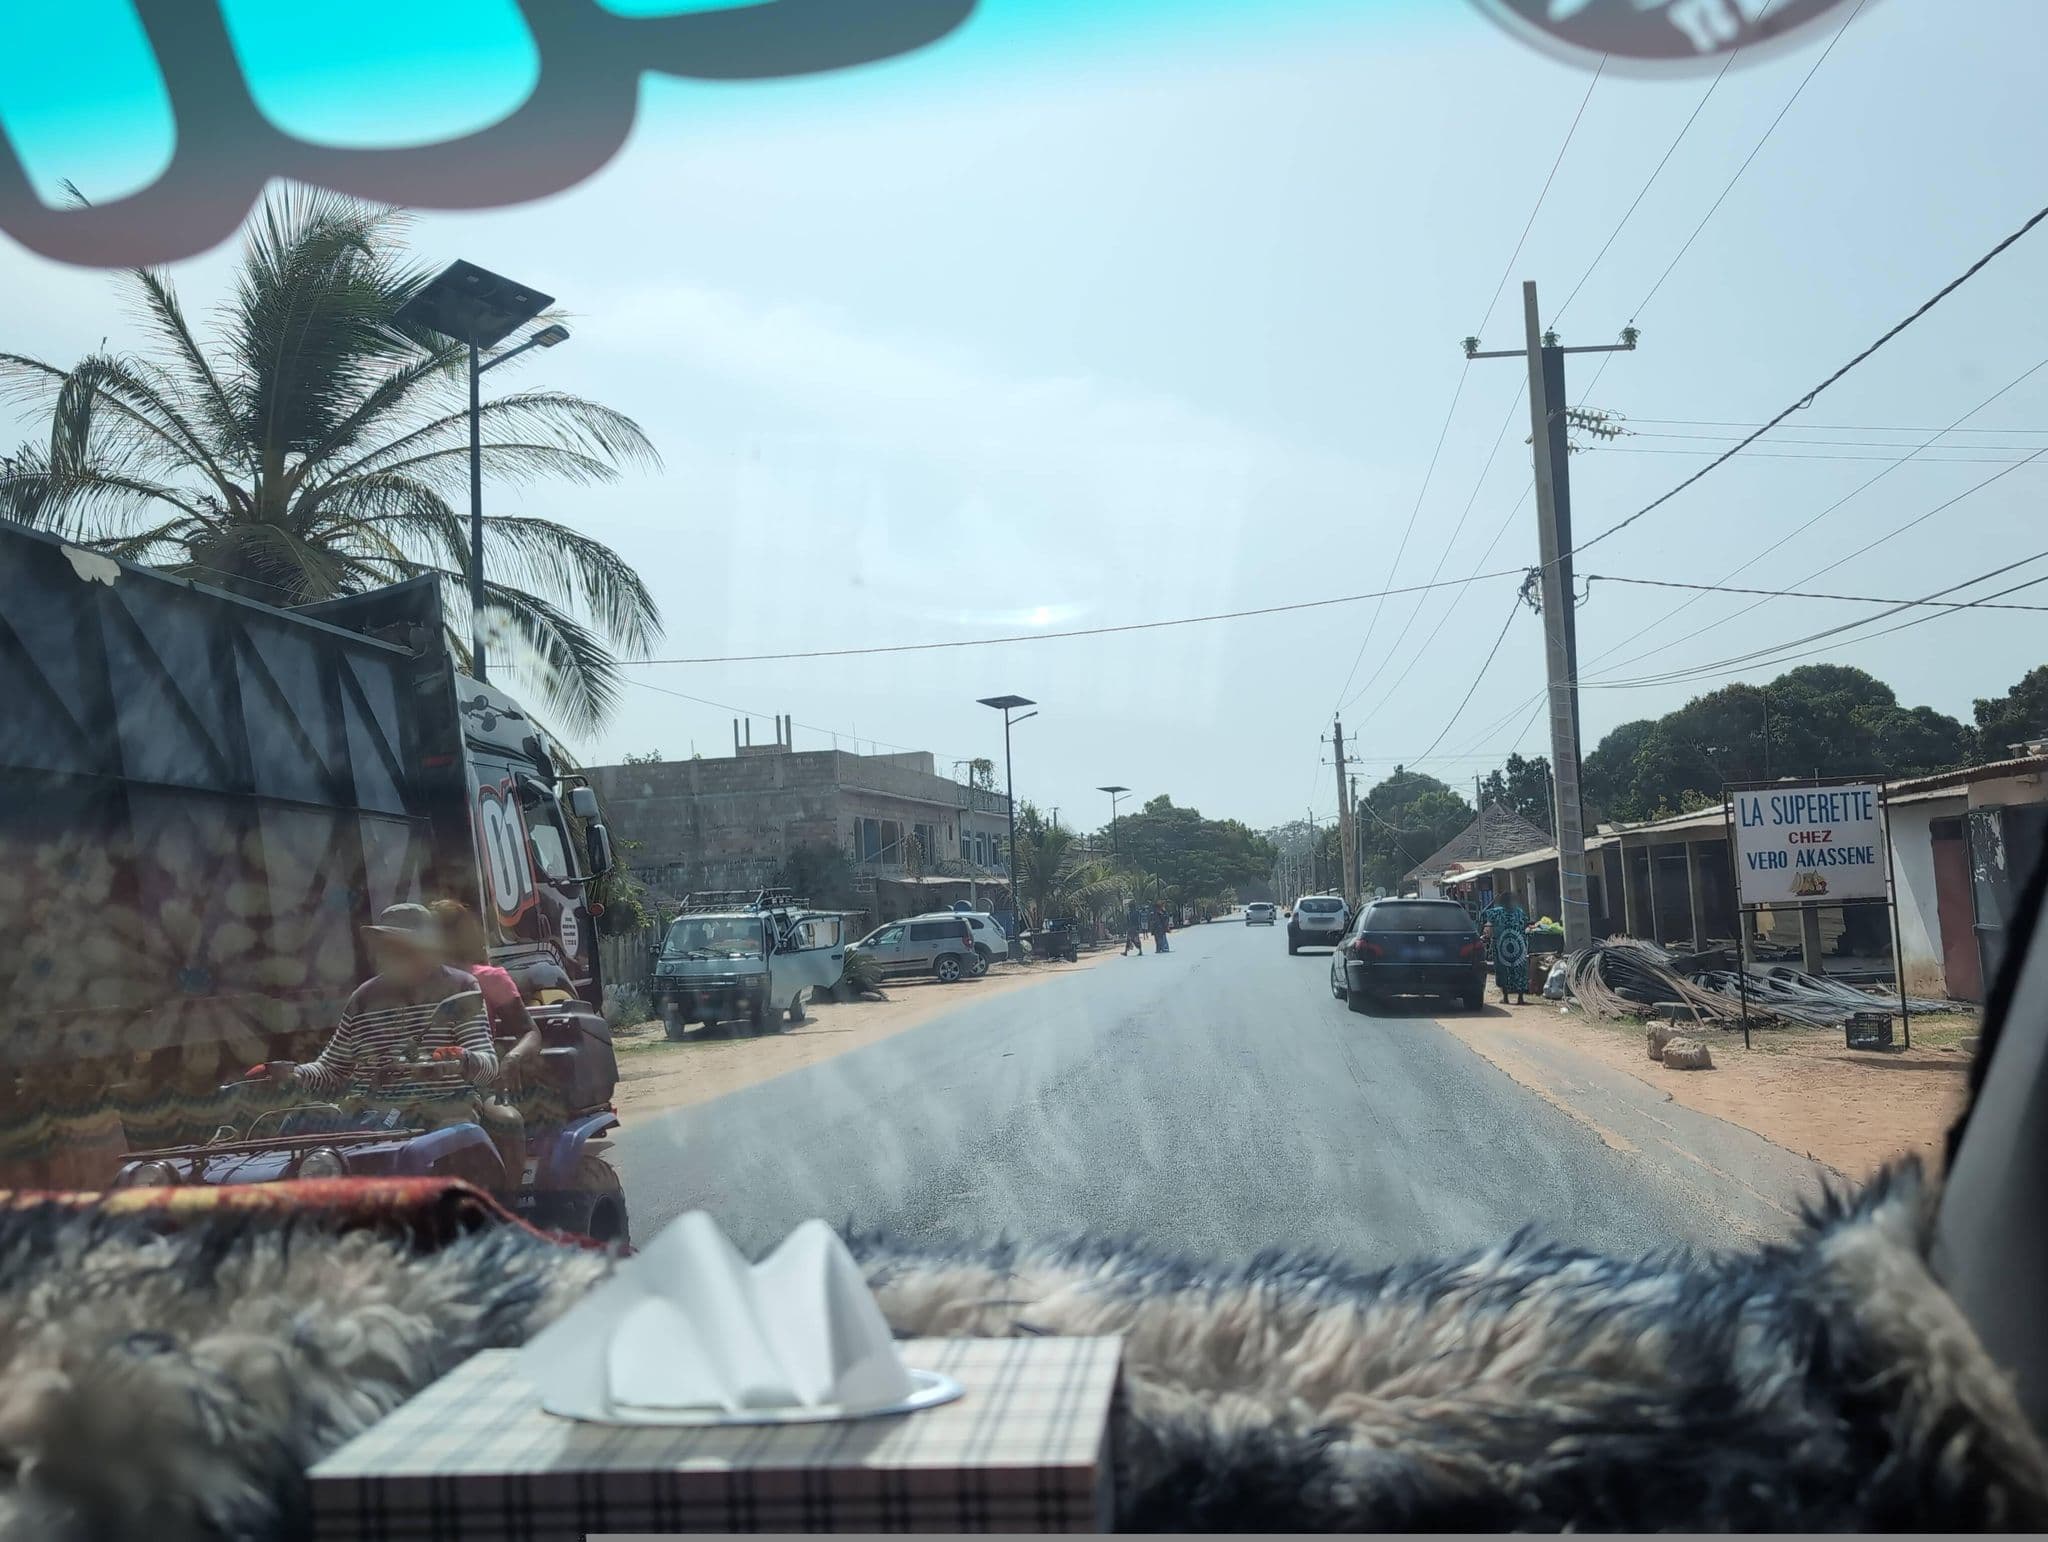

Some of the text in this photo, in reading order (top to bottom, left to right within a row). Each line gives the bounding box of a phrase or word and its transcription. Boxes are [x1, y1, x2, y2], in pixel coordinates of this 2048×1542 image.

[1741, 791, 1872, 827] LA SUPERETTE
[1788, 830, 1833, 844] CHEZ
[1747, 846, 1875, 870] VERO AKASSENE
